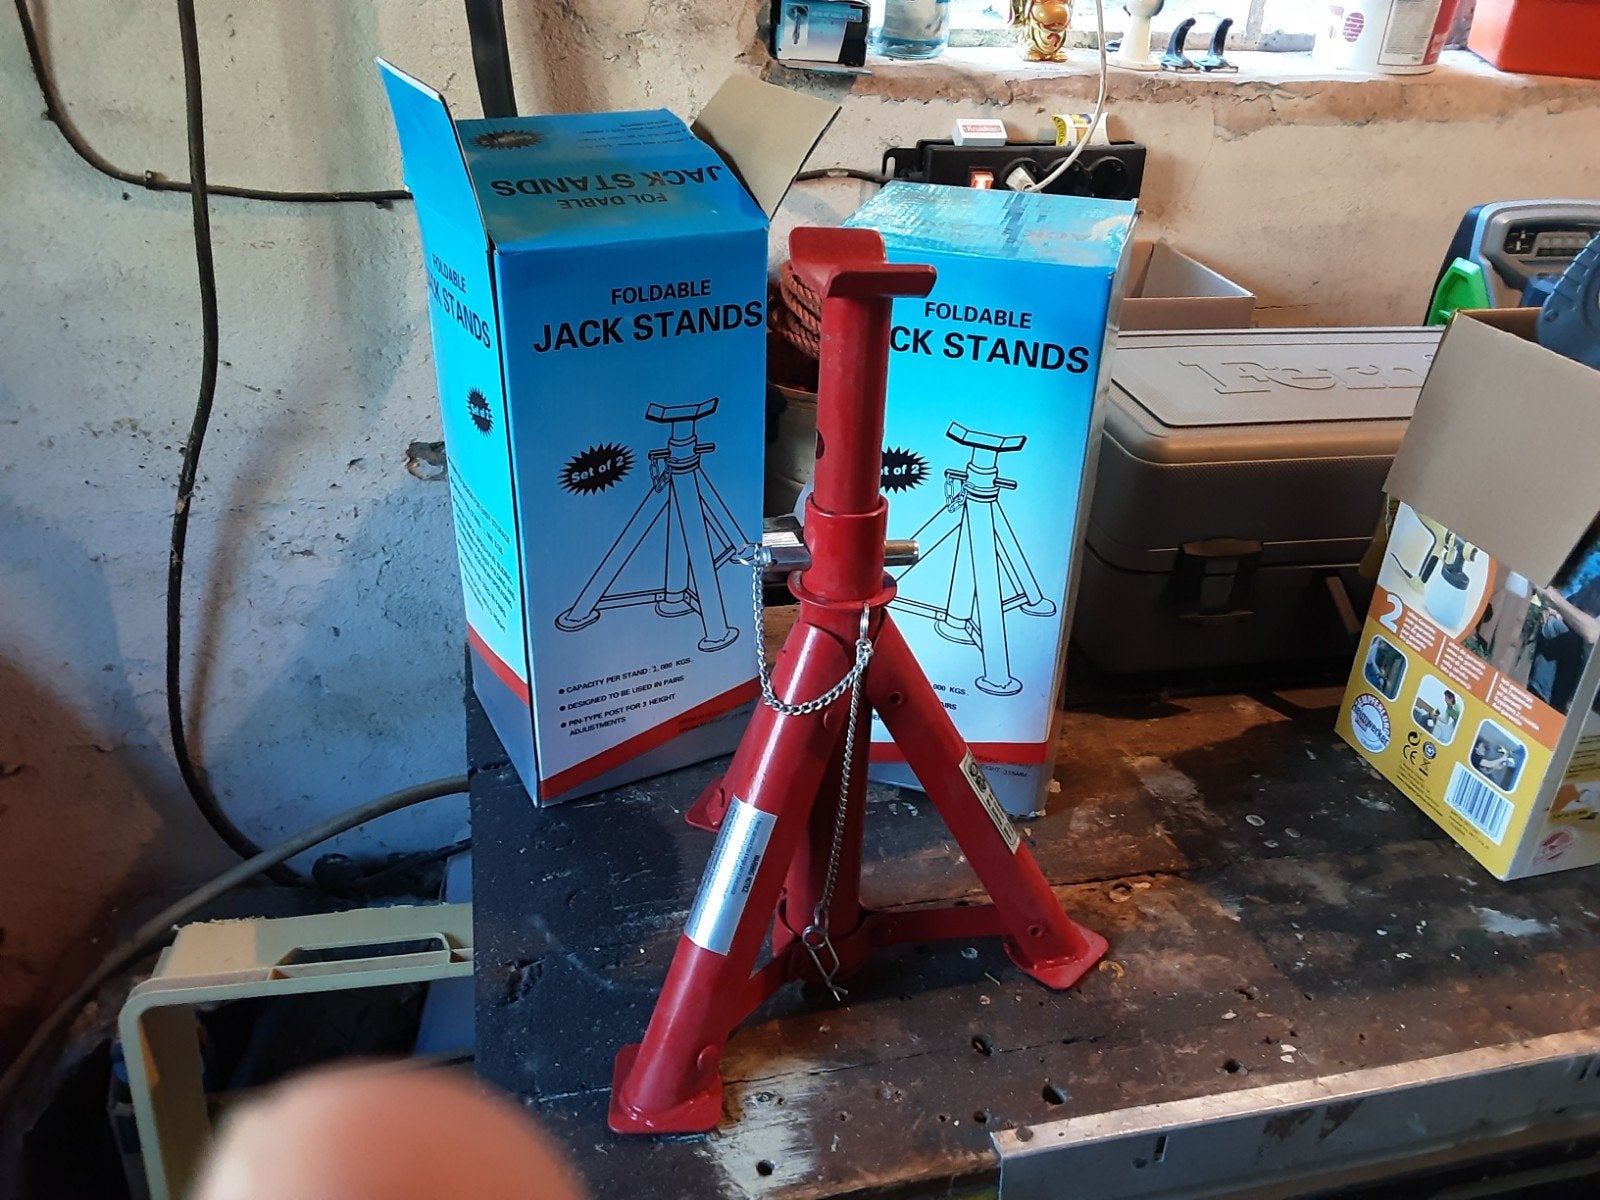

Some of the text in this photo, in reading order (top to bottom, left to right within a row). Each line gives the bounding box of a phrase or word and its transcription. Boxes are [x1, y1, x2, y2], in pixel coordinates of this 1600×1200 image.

[490, 165, 722, 197] JACK STANDS
[556, 193, 668, 210] FOLDABLE
[432, 253, 466, 294] FOLDABLE
[611, 279, 712, 305] FOLDABLE
[442, 287, 491, 349] STANDS
[533, 300, 763, 352] JACK STANDS
[924, 301, 1033, 329] FOLDABLE
[889, 326, 1089, 374] CK STANDS
[571, 455, 625, 483] Set of 2
[893, 464, 907, 475] of
[910, 463, 920, 475] 2
[1379, 593, 1404, 633] 2
[566, 679, 605, 693] CAPACITY
[606, 674, 621, 684] PER
[567, 675, 685, 710] DESIGNED TO BE USED IN PAIRS
[568, 712, 603, 727] PIN-TYPE
[604, 707, 624, 718] POST
[626, 702, 641, 712] FOR
[649, 693, 677, 705] HEIGHT
[569, 716, 626, 737] ADJUSTMENTS
